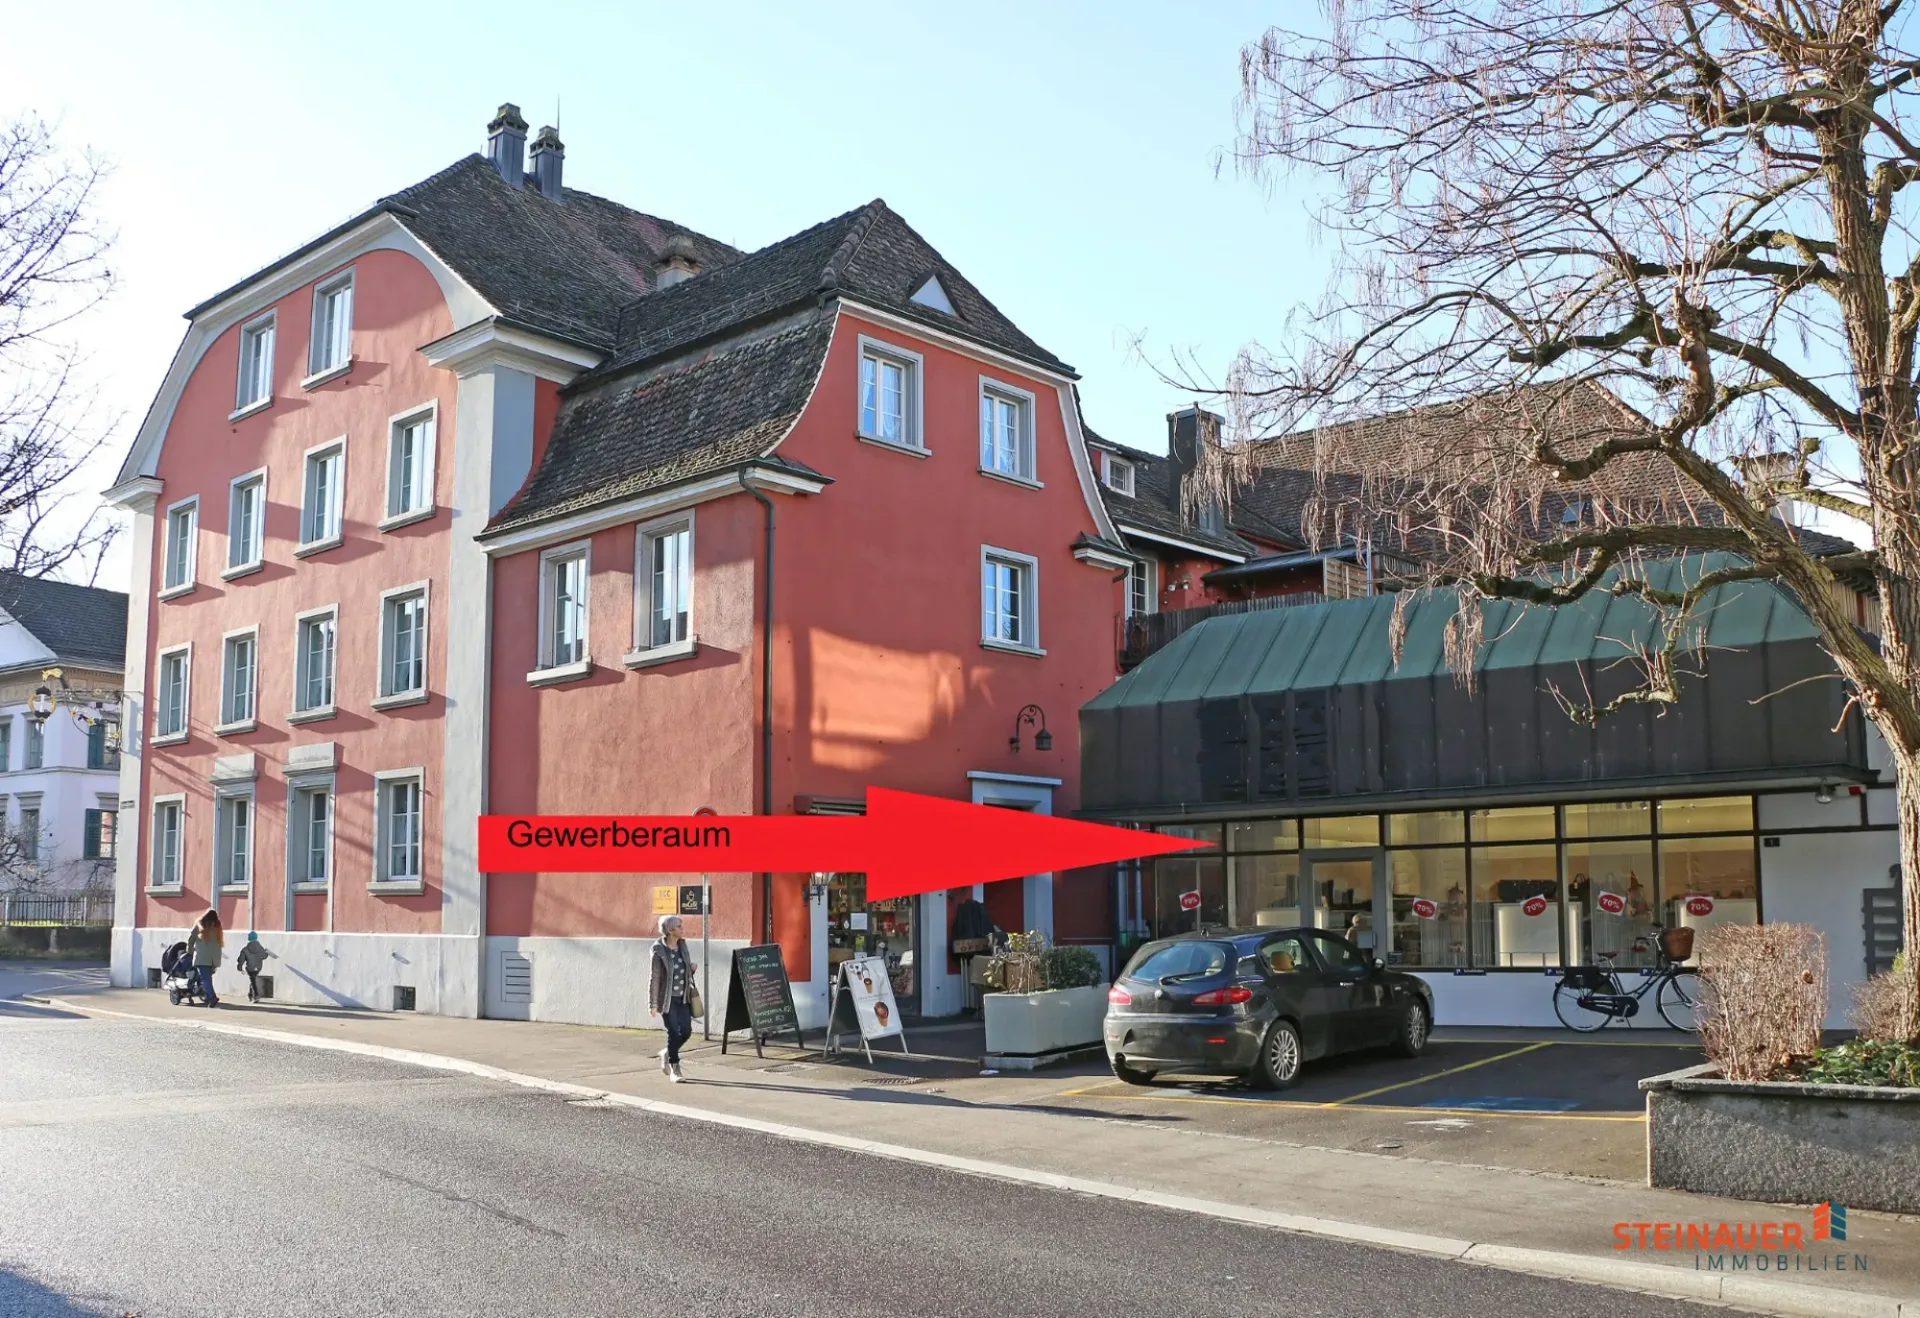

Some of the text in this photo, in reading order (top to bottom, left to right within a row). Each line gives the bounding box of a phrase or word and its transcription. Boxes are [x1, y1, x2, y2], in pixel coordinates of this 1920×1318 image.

[1416, 903, 1433, 914] 70%
[1526, 901, 1544, 912] 70%
[1602, 898, 1620, 909] 70%
[1690, 903, 1710, 911] 70%
